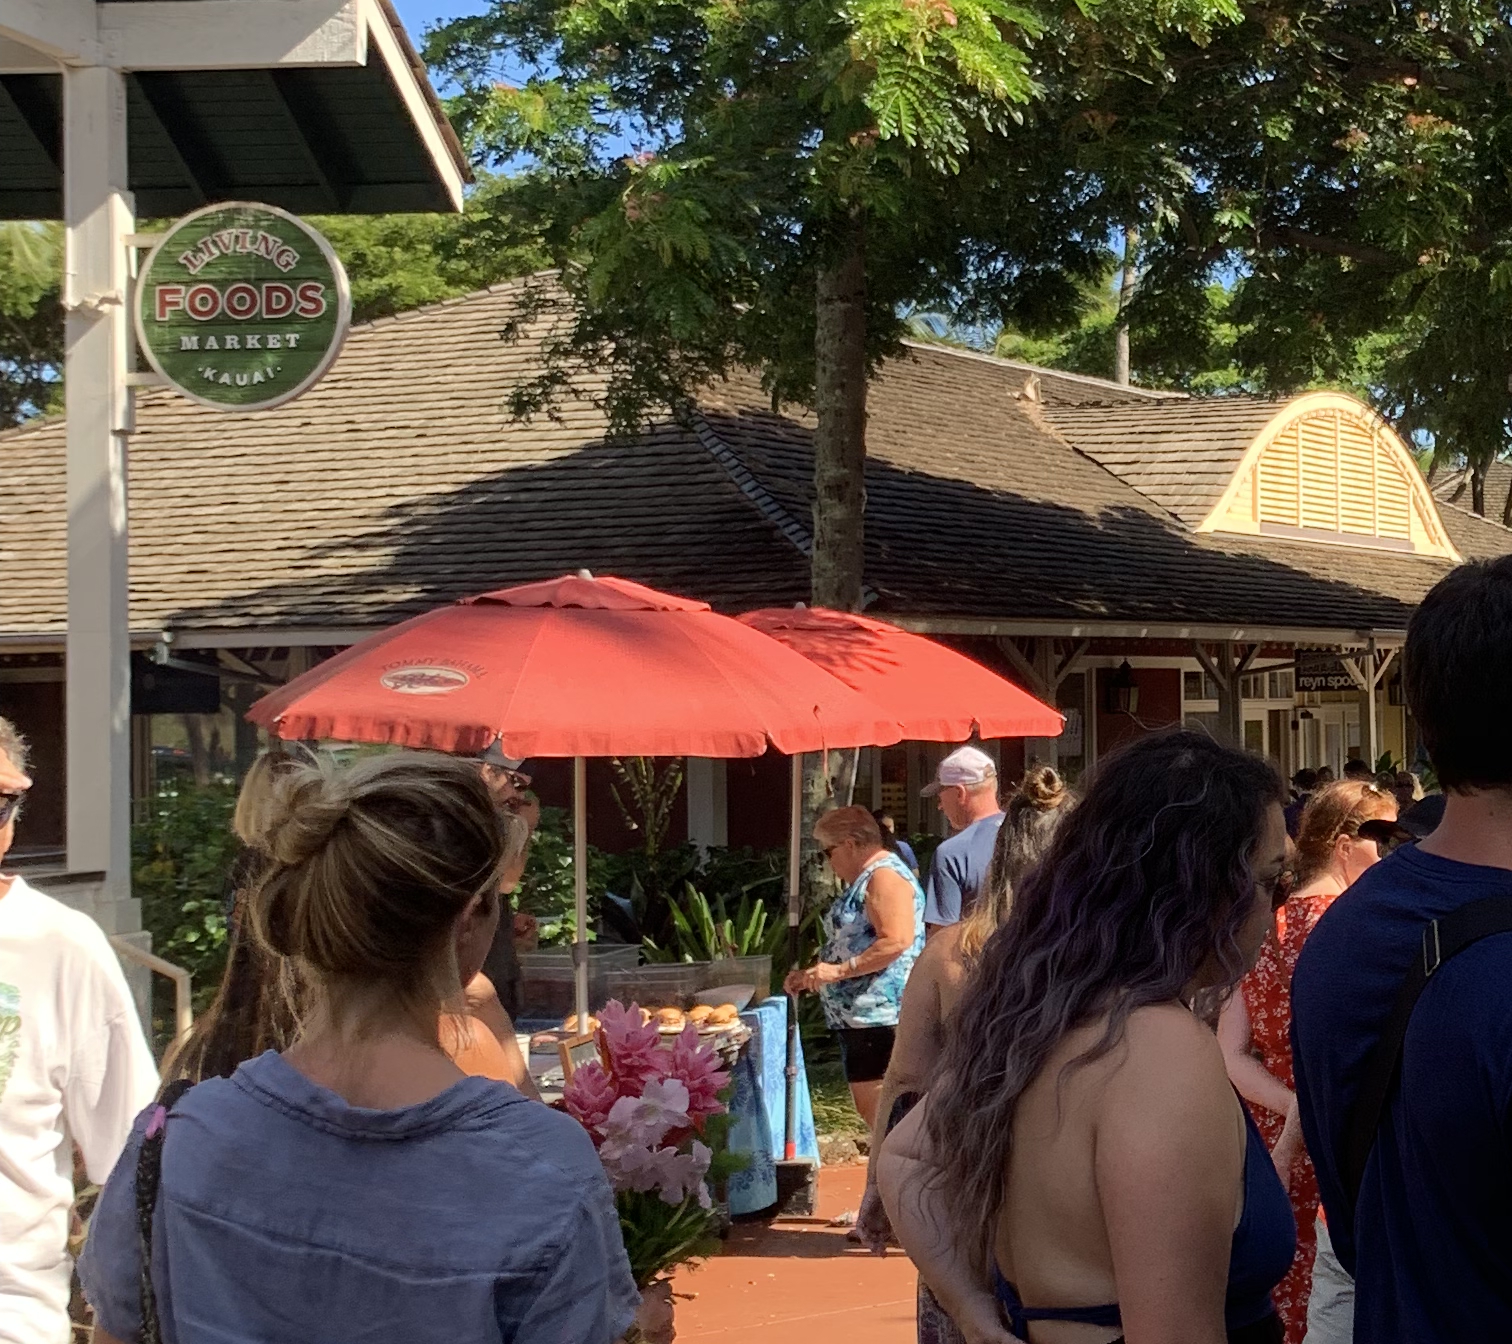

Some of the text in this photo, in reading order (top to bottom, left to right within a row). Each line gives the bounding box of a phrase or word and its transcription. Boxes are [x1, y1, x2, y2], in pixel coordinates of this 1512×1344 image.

[178, 228, 300, 274] LIVING
[155, 282, 326, 321] FOODS
[180, 333, 300, 351] MARKET
[202, 366, 276, 387] KAUAI
[381, 657, 434, 672] TOMMY
[1299, 676, 1357, 690] reyn spoo
